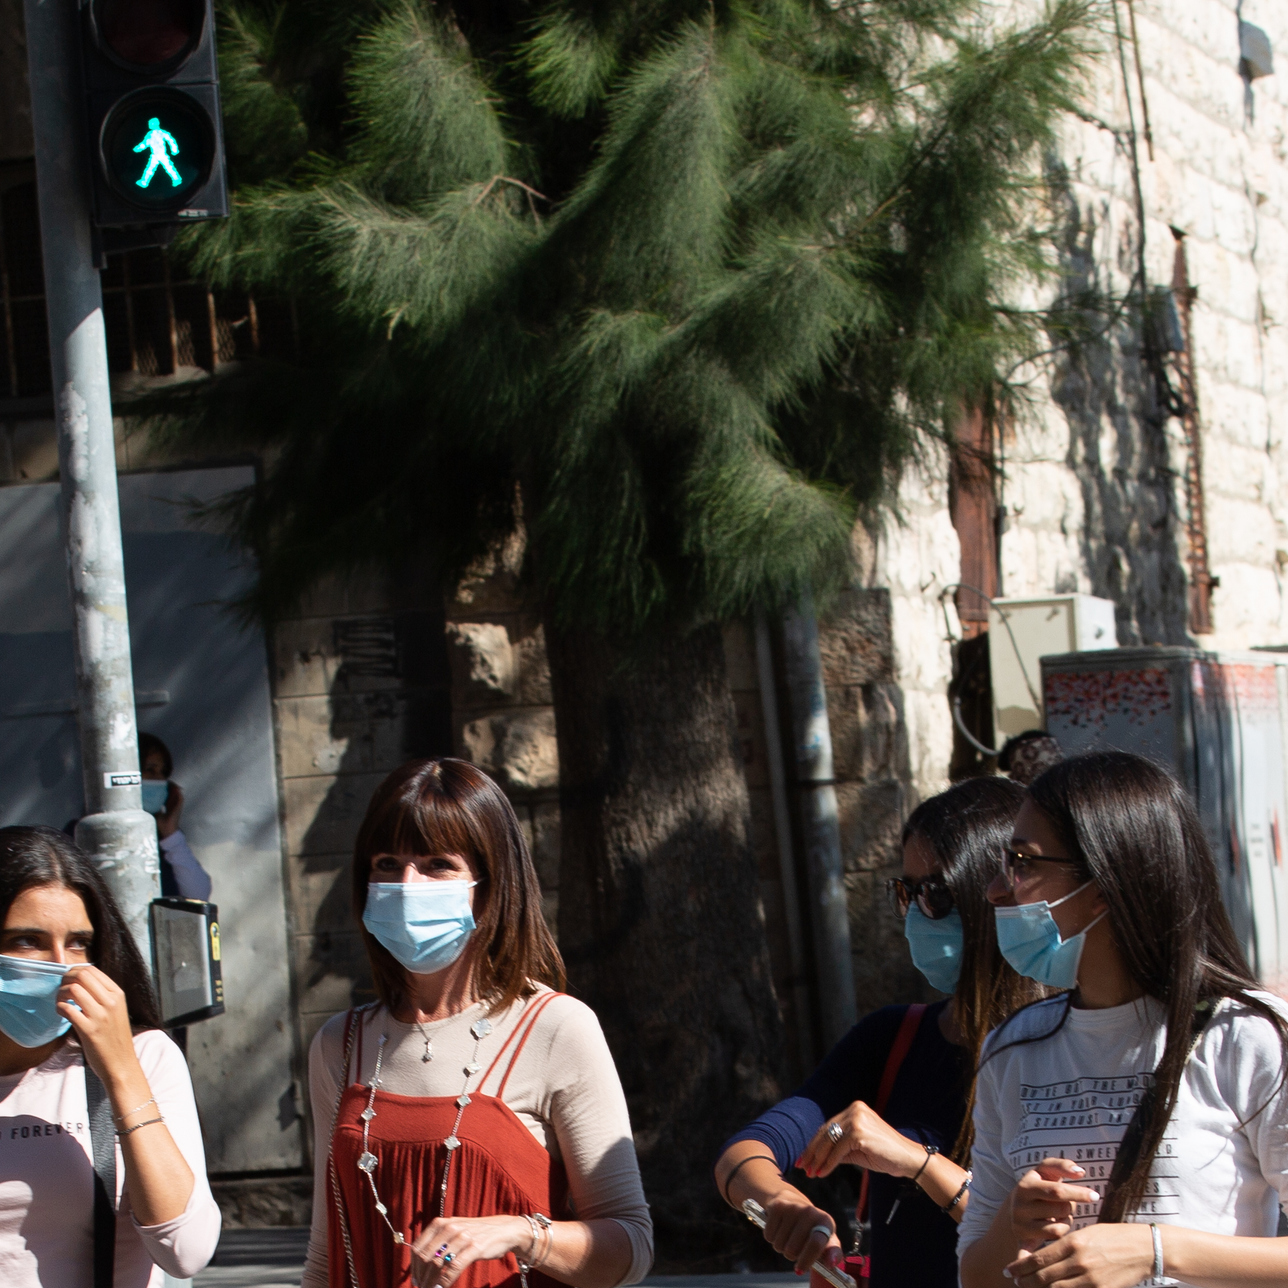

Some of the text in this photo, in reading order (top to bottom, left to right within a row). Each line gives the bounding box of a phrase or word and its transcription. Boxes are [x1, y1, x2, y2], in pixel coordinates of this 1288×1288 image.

[1093, 1079, 1117, 1091] THE
[1049, 1103, 1062, 1112] IN
[1035, 1113, 1100, 1128] STARDUST
[10, 1121, 84, 1140] FOREVER
